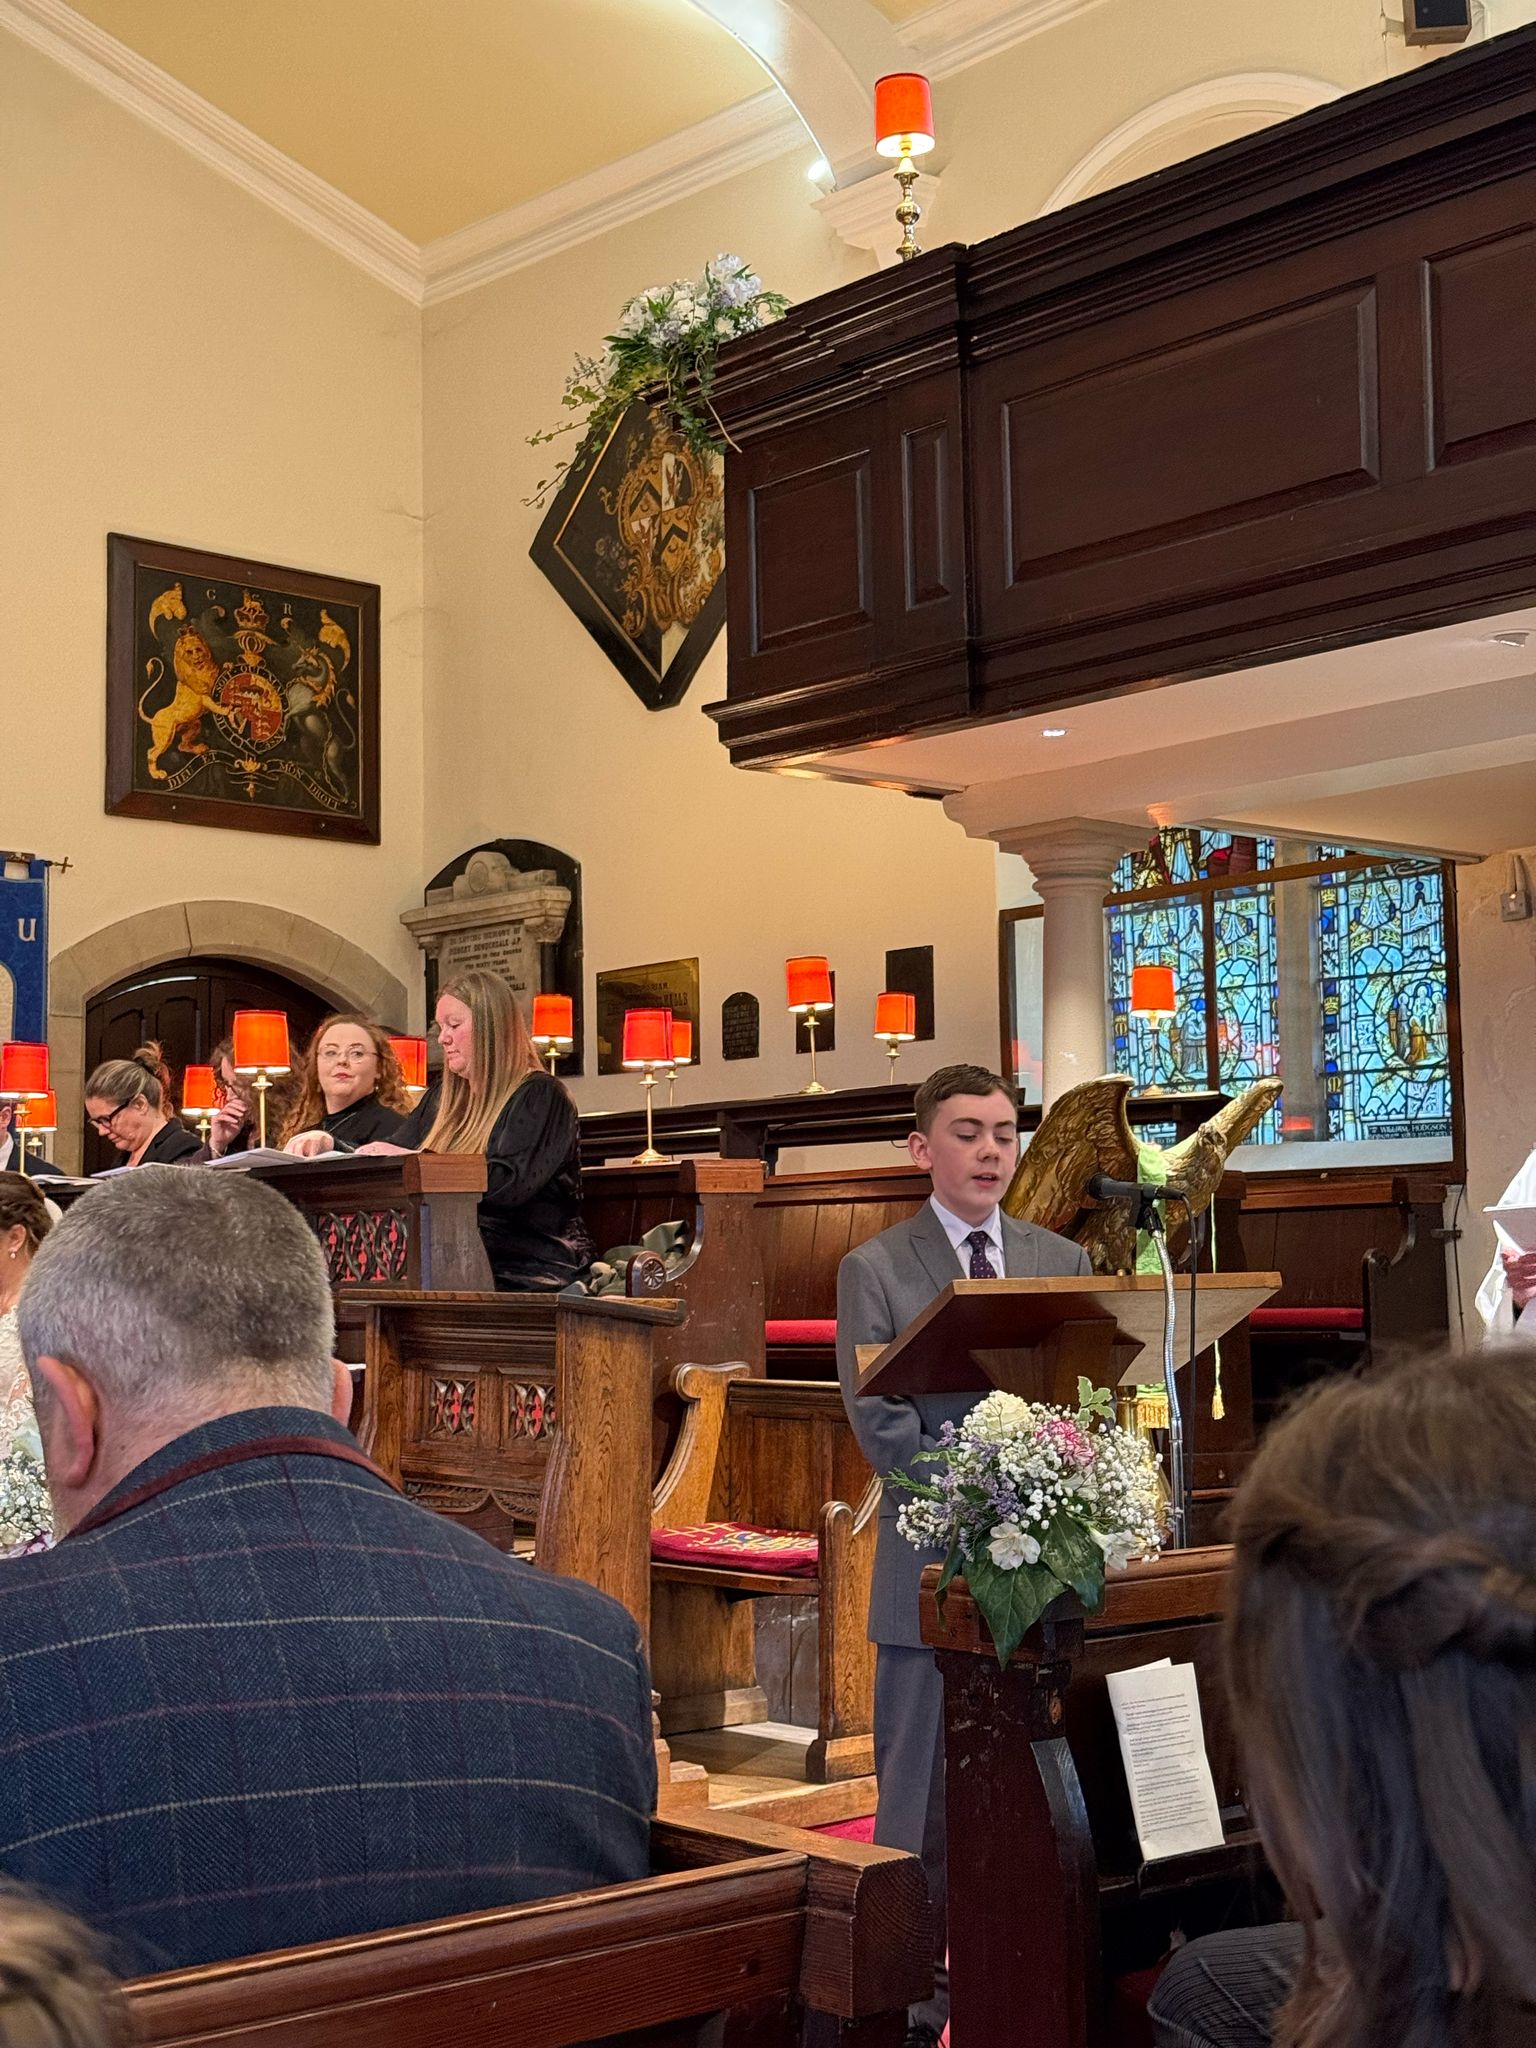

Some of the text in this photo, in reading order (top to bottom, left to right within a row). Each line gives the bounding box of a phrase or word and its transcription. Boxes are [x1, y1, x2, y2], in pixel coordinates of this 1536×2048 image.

[283, 602, 293, 616] R
[201, 752, 217, 764] ET
[308, 782, 342, 810] DROIT
[1411, 1123, 1447, 1132] HODGSON
